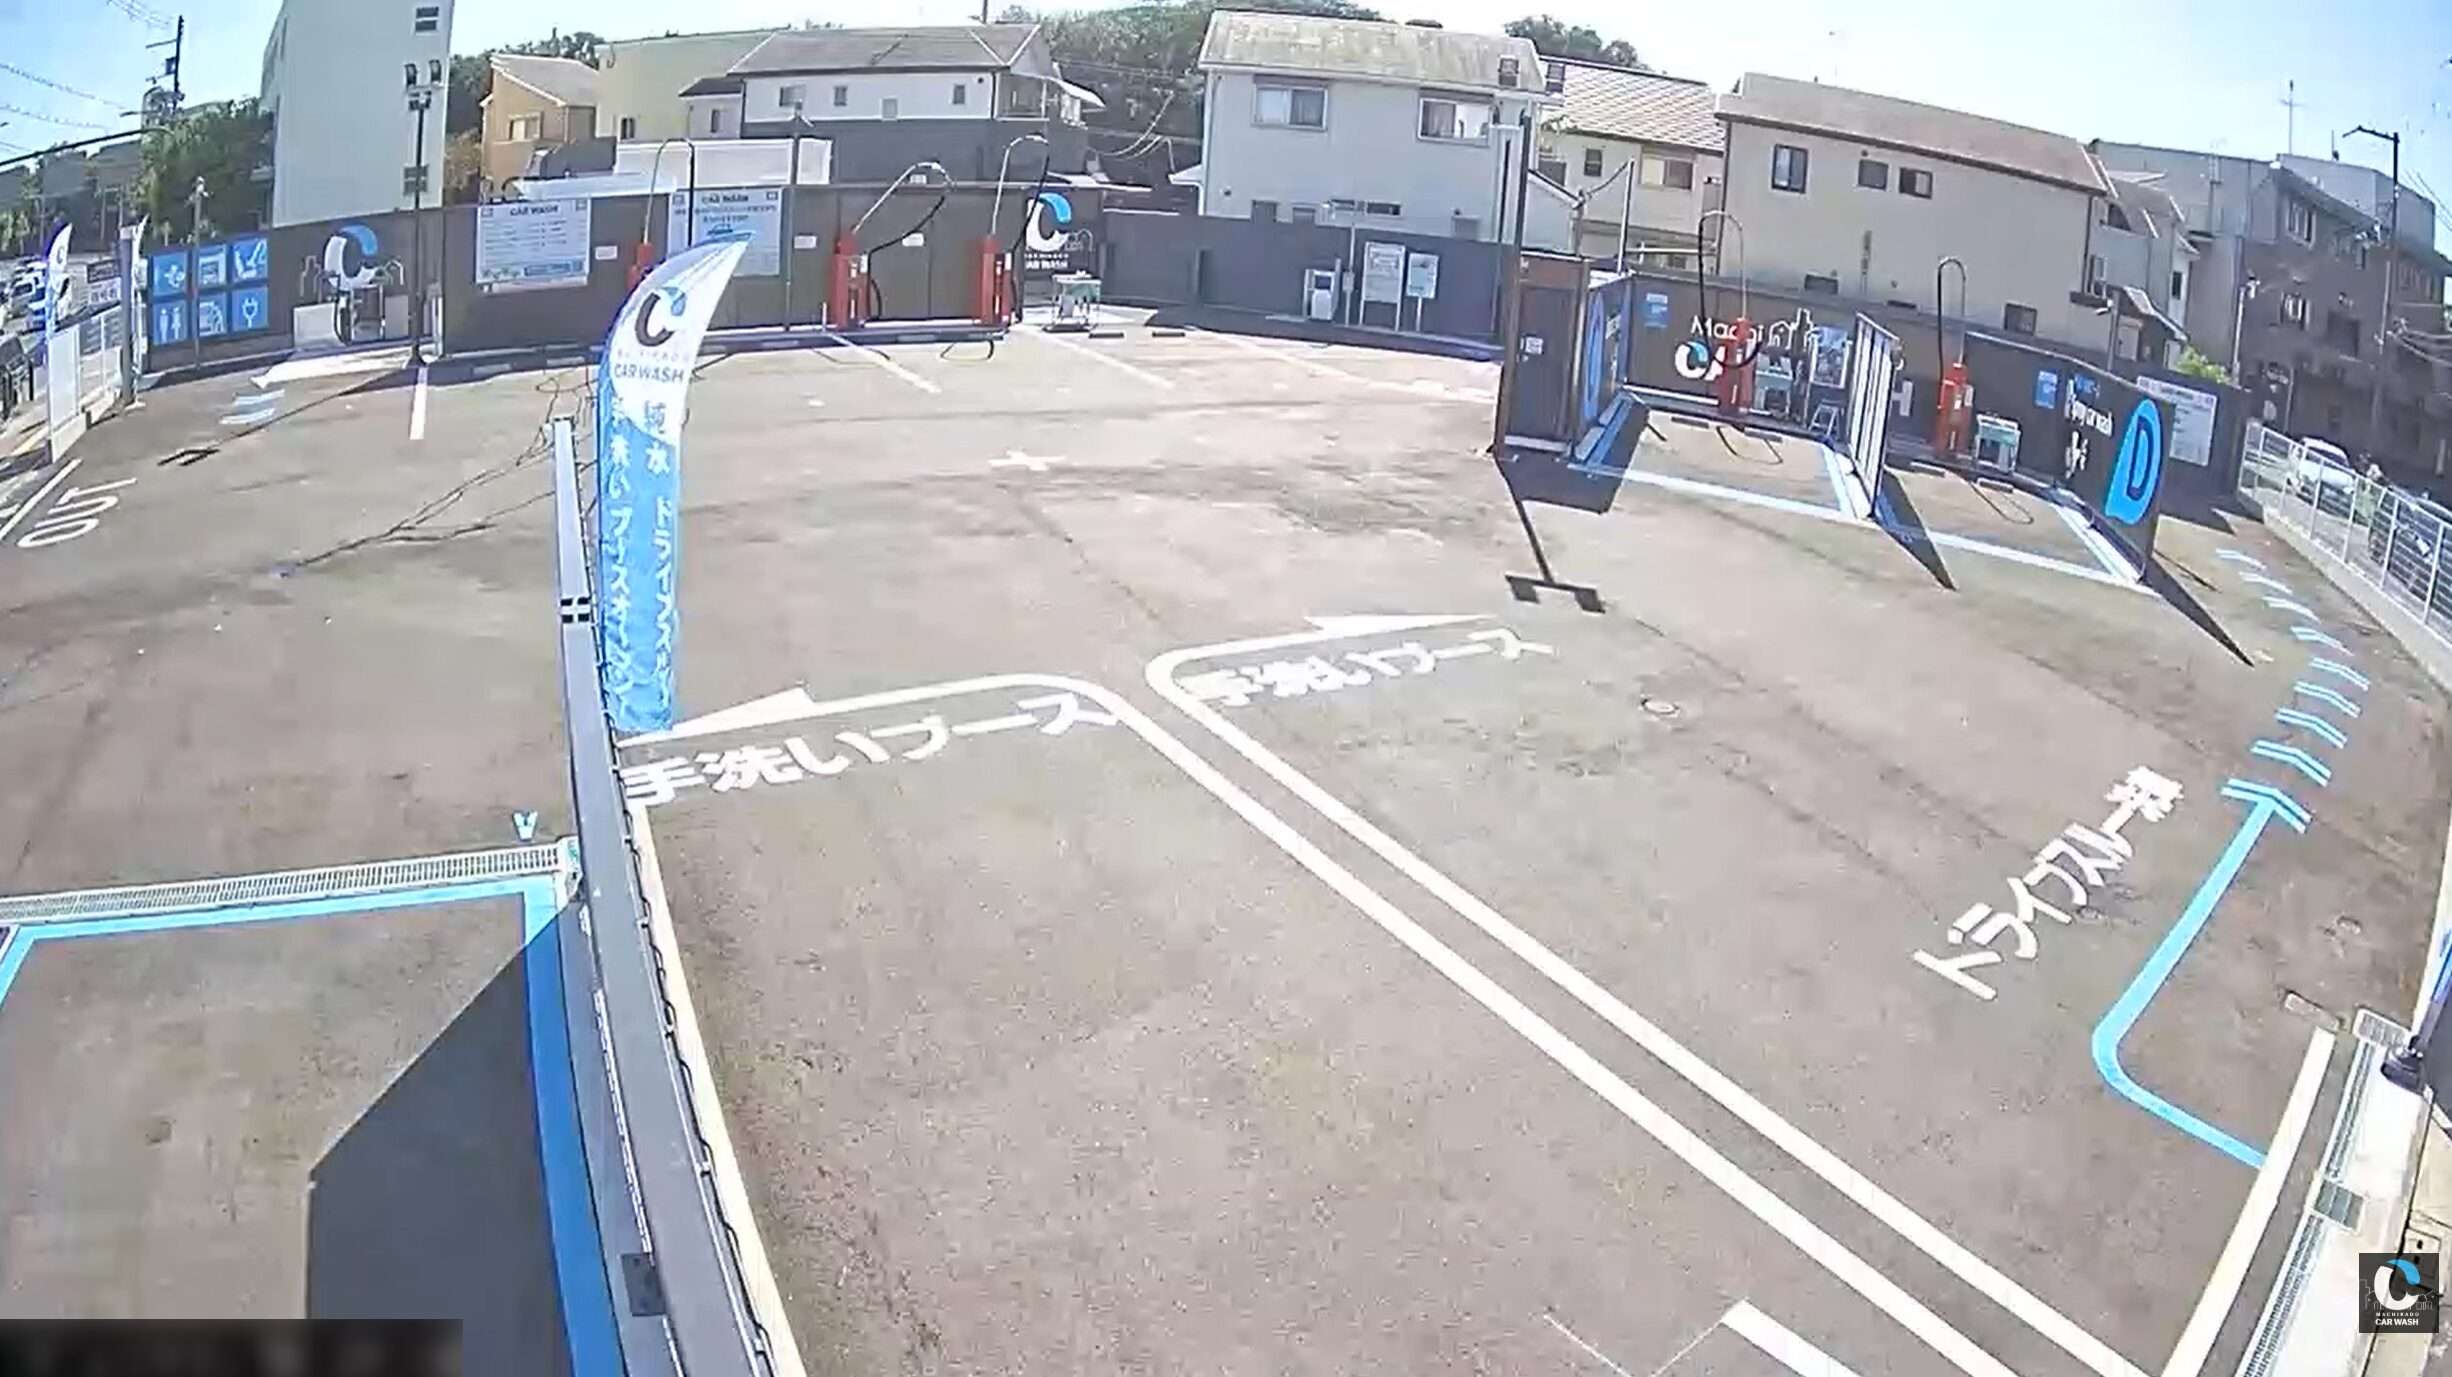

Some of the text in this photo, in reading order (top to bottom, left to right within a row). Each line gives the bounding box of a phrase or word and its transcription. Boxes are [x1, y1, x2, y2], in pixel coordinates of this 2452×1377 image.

[17, 477, 137, 547] OUT
[620, 692, 1119, 804] 手洗いブース
